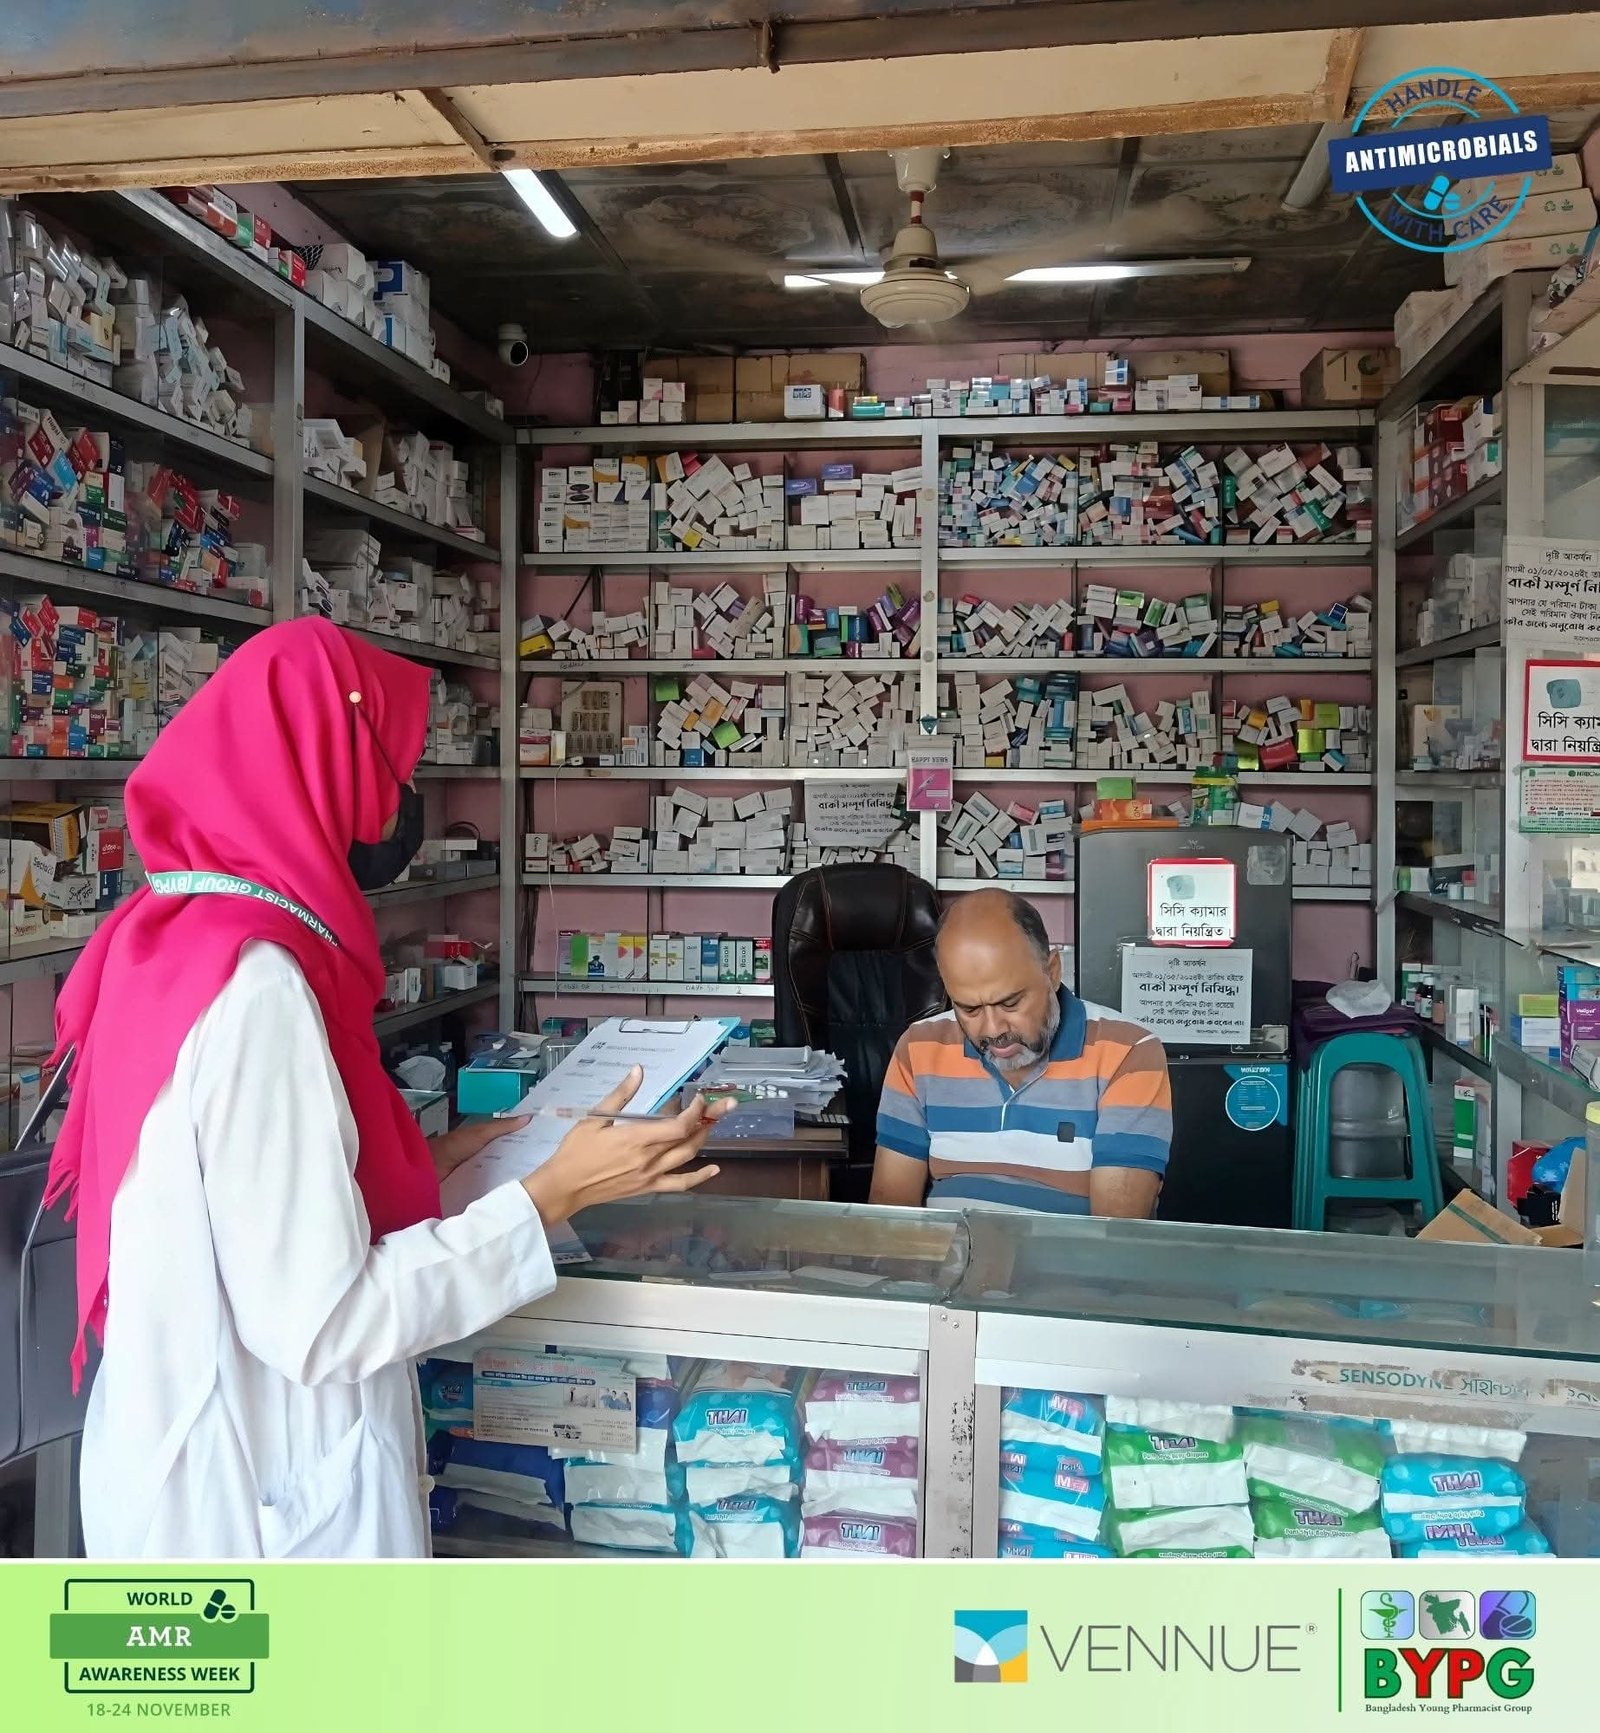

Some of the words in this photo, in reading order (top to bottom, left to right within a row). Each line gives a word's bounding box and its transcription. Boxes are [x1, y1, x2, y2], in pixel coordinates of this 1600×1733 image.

[1508, 576, 1541, 590] বাকী
[1544, 579, 1581, 596] সম্পূর্ণ
[1537, 711, 1569, 729] সিসি
[1531, 738, 1558, 753] দ্বারা
[194, 877, 252, 894] GROUP
[1160, 903, 1186, 918] সিসি
[1155, 926, 1177, 937] দ্বারা
[1181, 923, 1225, 938] নিয়ন্ত্রিত
[1139, 981, 1166, 992] বাকী
[1169, 983, 1199, 996] সম্পূর্ণ
[847, 1381, 886, 1392] THAI
[1339, 1368, 1453, 1389] SENSODYN
[706, 1408, 747, 1426] THAI
[1431, 1472, 1482, 1493] THAI
[1294, 1510, 1343, 1526] THAI
[841, 1523, 881, 1541] THAI
[1425, 1523, 1476, 1540] THAI
